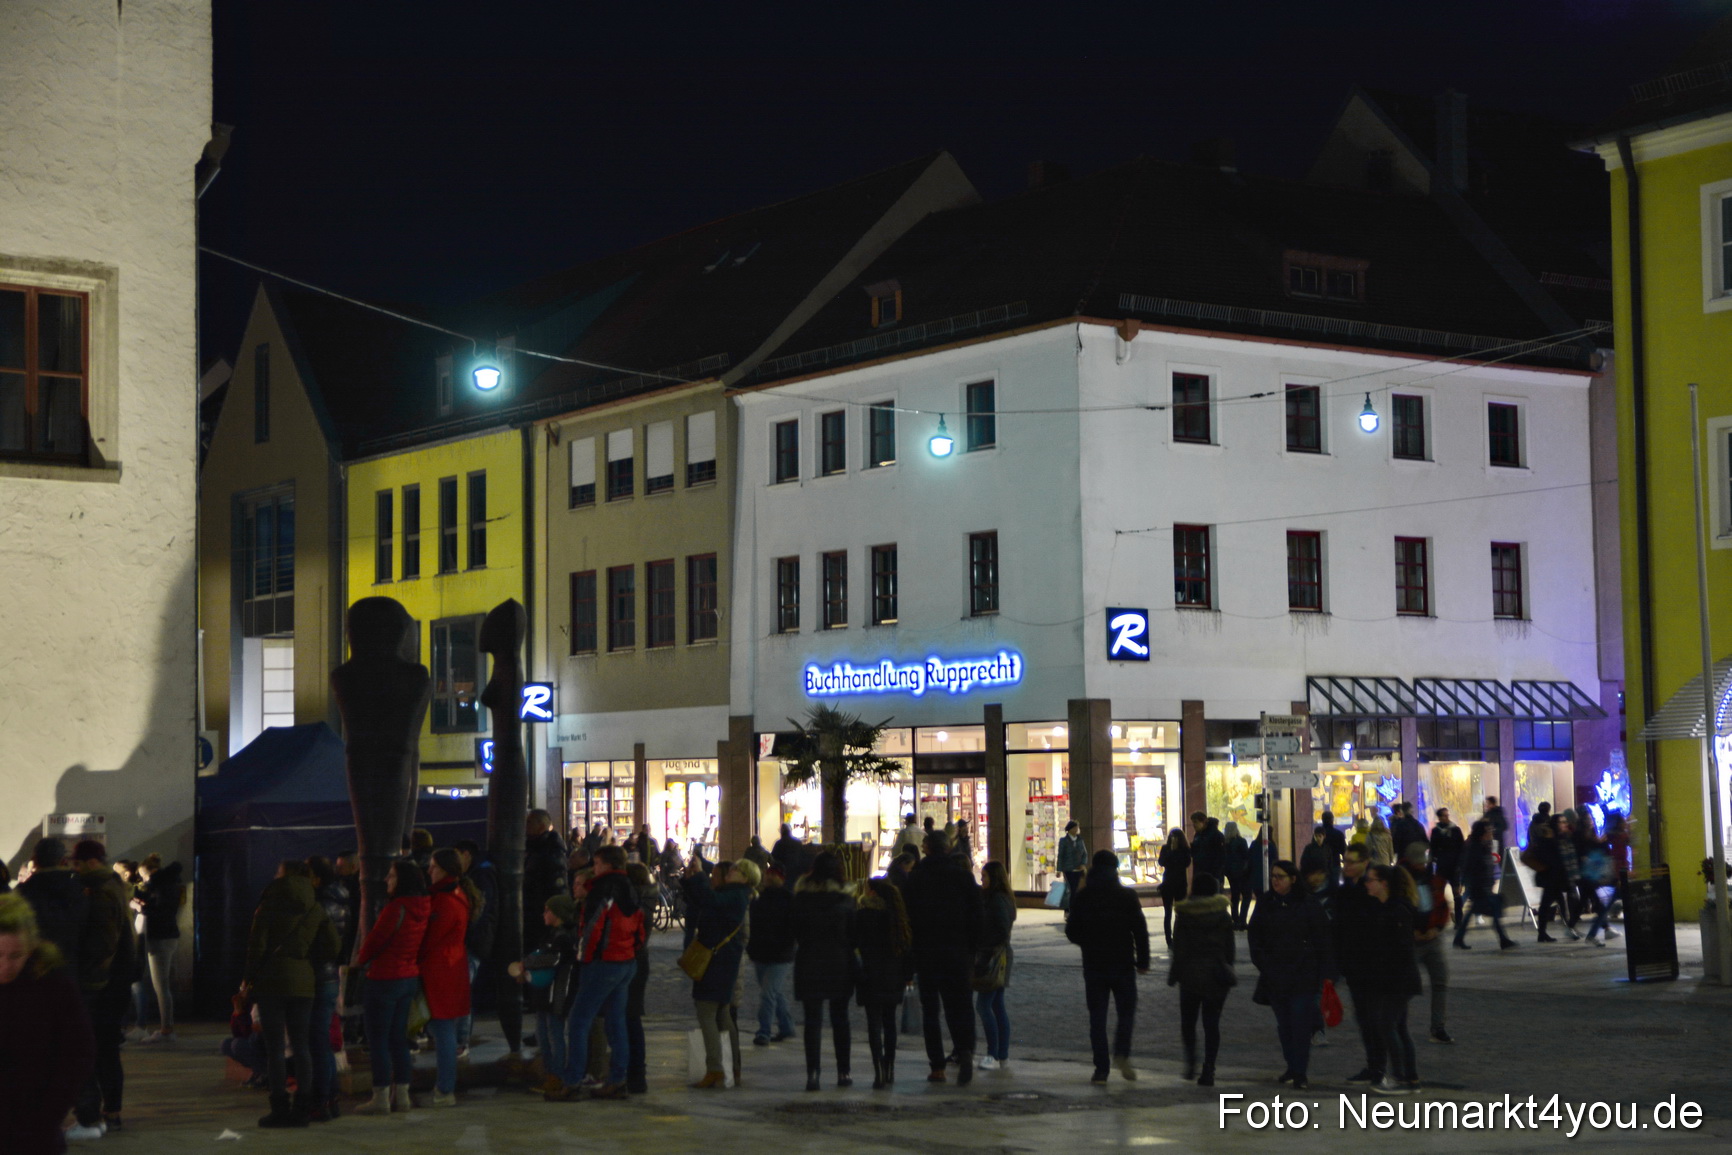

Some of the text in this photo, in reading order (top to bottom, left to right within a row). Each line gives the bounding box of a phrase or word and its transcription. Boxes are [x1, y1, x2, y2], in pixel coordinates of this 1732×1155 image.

[806, 655, 1015, 691] Buchhandlung Rupprecht
[1269, 716, 1302, 726] Klostergasse
[50, 816, 96, 824] NEUMARKT
